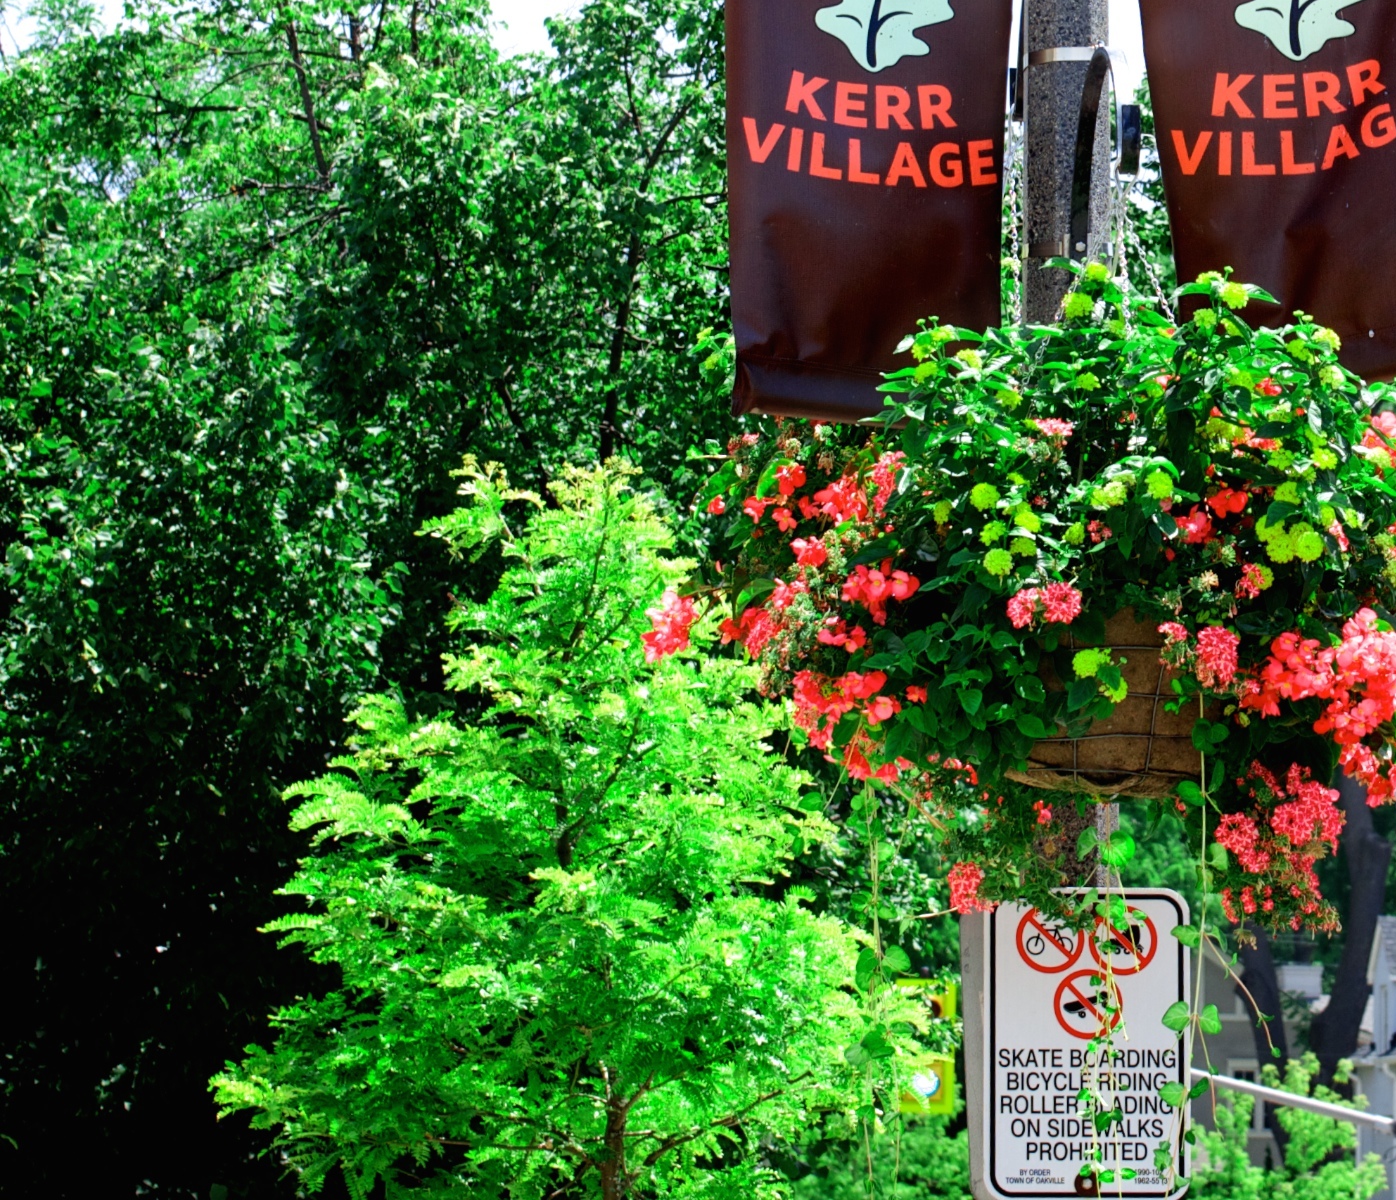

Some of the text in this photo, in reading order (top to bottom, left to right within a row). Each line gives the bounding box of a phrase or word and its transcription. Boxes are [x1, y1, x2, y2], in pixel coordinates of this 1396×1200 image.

[1211, 59, 1386, 119] KERR
[784, 70, 957, 130] KERR
[742, 117, 997, 188] VILLAGE
[999, 1049, 1176, 1068] SKATE BOARDING
[1007, 1072, 1168, 1091] BICYCLE RIDING
[1000, 1095, 1078, 1114] ROLLER
[1011, 1118, 1040, 1138] ON
[1026, 1142, 1147, 1161] PROHIBITED
[1019, 1168, 1051, 1176] BY ORDER
[1134, 1168, 1164, 1176] 1990-10
